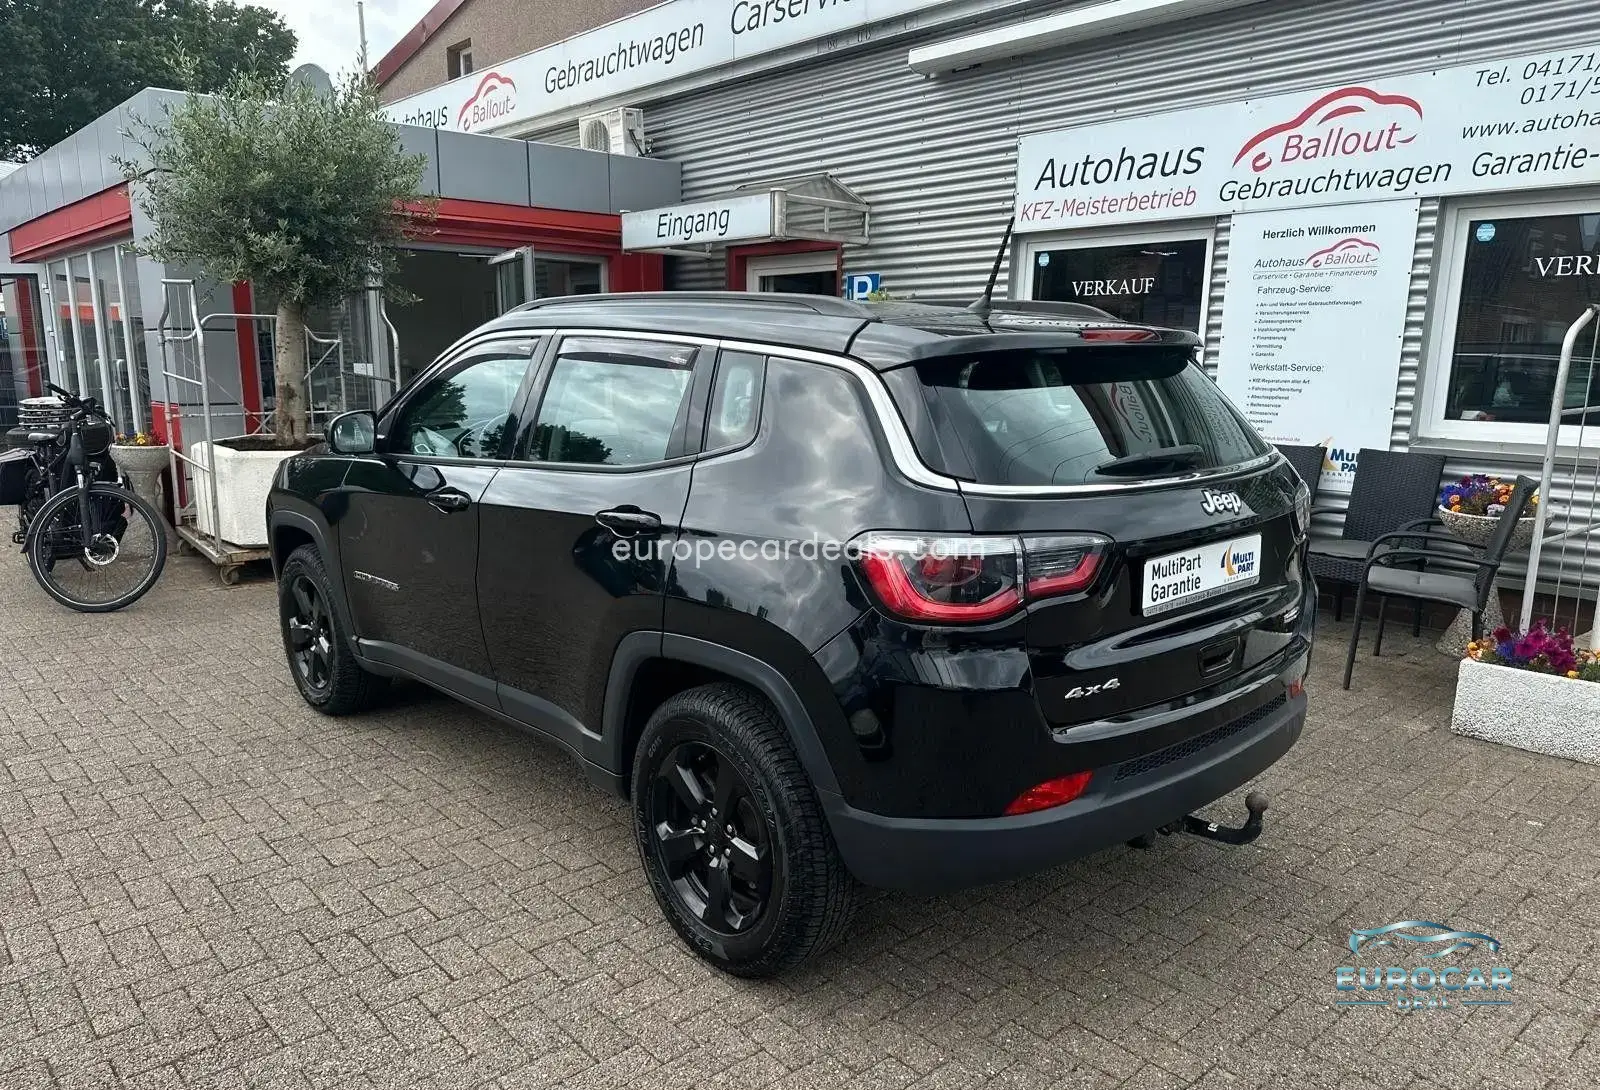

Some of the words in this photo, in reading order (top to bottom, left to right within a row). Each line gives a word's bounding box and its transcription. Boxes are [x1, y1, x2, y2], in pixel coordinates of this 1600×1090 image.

[472, 95, 512, 125] Ballout
[545, 22, 704, 94] Gebrauchtwagen
[731, 0, 850, 34] Carser
[1475, 65, 1511, 87] Tel.
[1520, 77, 1600, 105] 0171/5
[1462, 109, 1600, 139] www.autoha
[1280, 122, 1402, 163] Ballout
[1034, 146, 1205, 191] Autohaus
[1219, 162, 1452, 202] Gebrauchtwagen
[1472, 143, 1600, 177] Garantie-
[1020, 185, 1197, 221] KFZ-Meisterbetrieb
[657, 208, 730, 241] Eingang
[1262, 227, 1305, 239] Herzlich
[1307, 223, 1377, 237] Willkommen
[1254, 257, 1305, 268] Autohaus
[1324, 252, 1372, 265] Ballout
[1533, 254, 1600, 278] VER
[853, 275, 873, 301] P
[1071, 277, 1155, 297] VERKAUF
[1252, 272, 1289, 281] Carservice
[1293, 270, 1324, 279] Garantie
[1328, 269, 1378, 278] Finanzierung
[1250, 362, 1325, 373] Werkstatt-Service:
[1201, 490, 1242, 515] Jeep
[1151, 553, 1202, 581] MultiPart
[1237, 561, 1255, 575] PART
[1151, 573, 1202, 603] Garantie
[1064, 677, 1120, 699] 4x4
